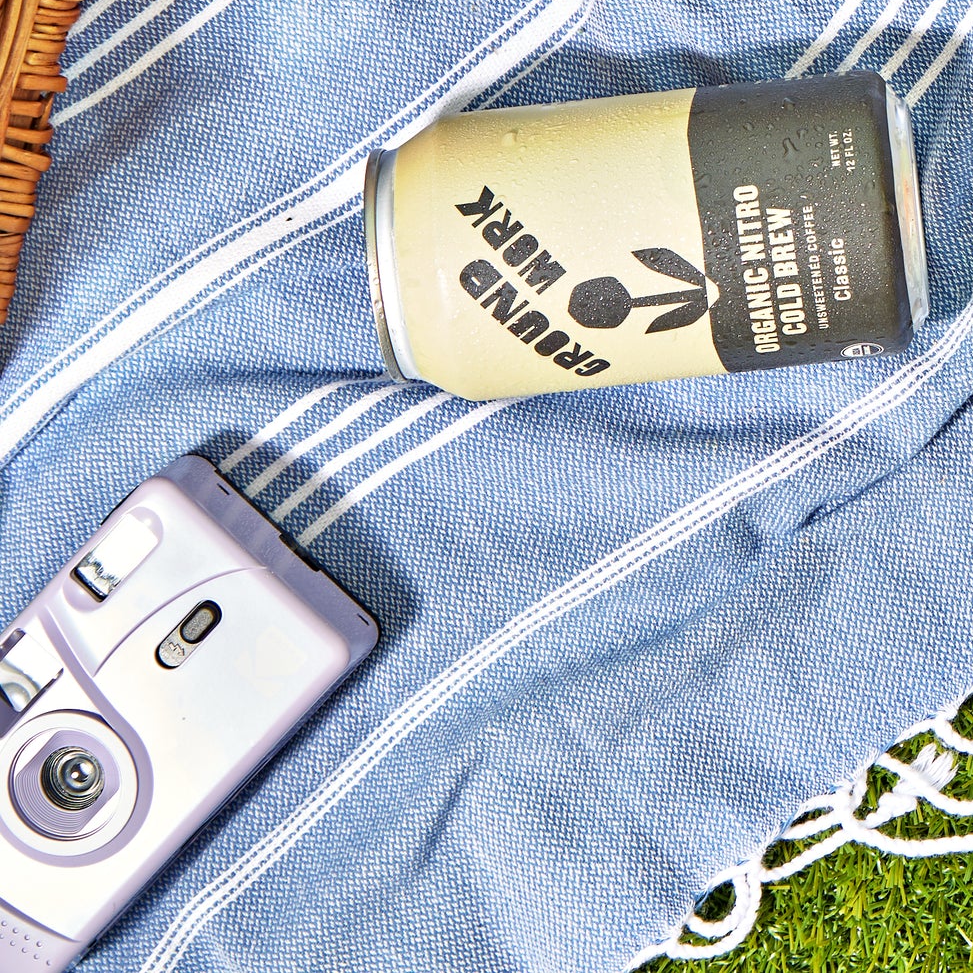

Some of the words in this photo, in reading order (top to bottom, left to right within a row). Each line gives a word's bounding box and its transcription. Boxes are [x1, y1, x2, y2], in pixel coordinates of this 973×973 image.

[828, 130, 839, 147] WT.
[830, 148, 841, 167] NET
[842, 128, 853, 144] OZ.
[844, 145, 854, 158] FL
[845, 159, 856, 172] 12
[454, 185, 567, 295] WORK
[733, 184, 766, 263] NITRO
[766, 208, 799, 278] BREW
[803, 205, 818, 252] COFFEE
[808, 256, 830, 330] UNSWEETENED
[827, 238, 851, 301] Classic
[459, 259, 611, 376] GROUND
[743, 267, 781, 354] ORGANIC
[776, 283, 808, 336] COLD
